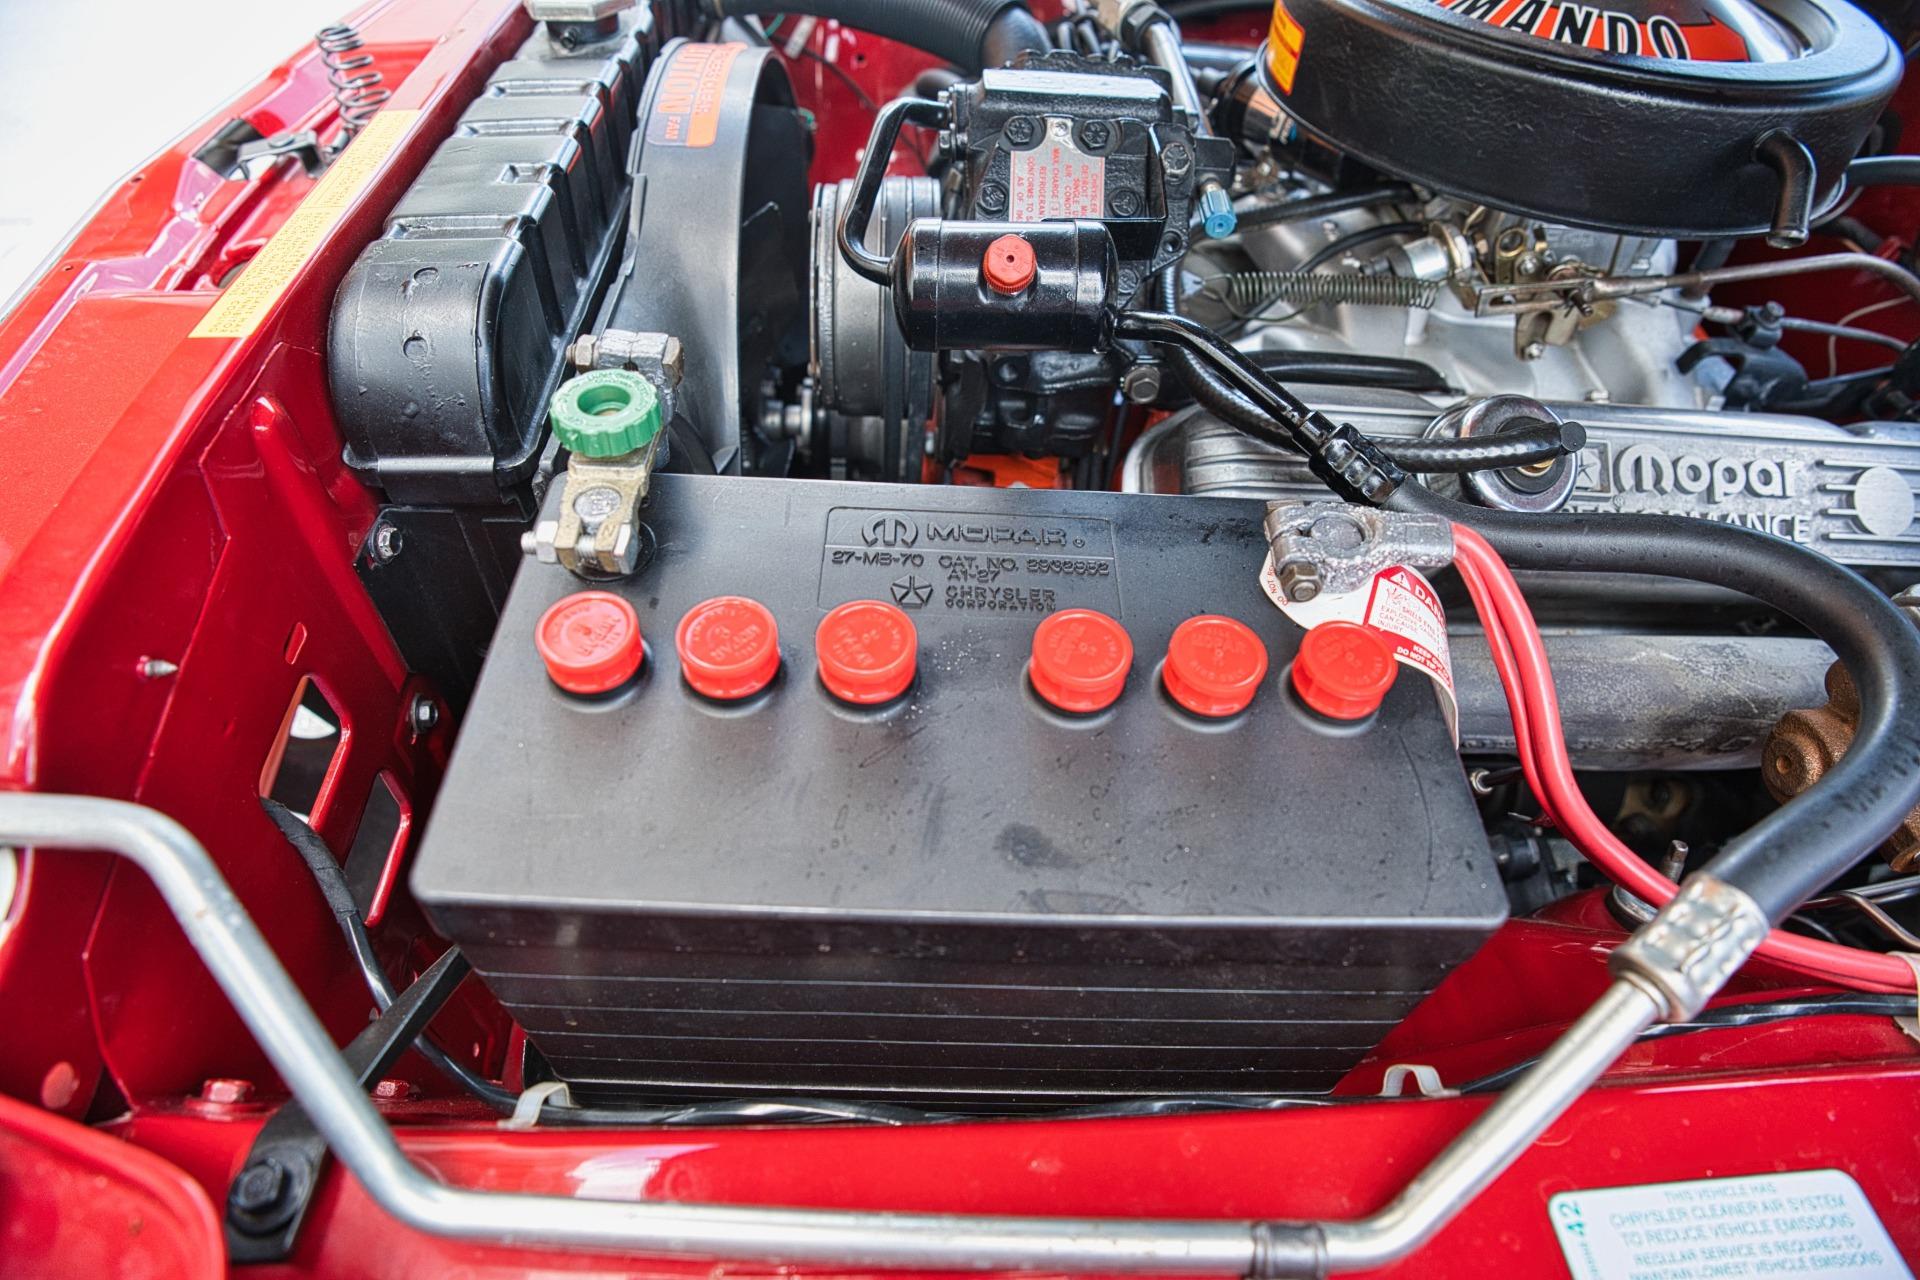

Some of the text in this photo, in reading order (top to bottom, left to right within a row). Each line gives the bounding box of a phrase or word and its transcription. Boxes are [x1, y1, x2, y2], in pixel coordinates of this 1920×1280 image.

[665, 116, 681, 139] FAN
[1017, 176, 1024, 186] AS
[1026, 156, 1035, 199] CONFORMS
[1064, 164, 1072, 178] AIR
[1081, 165, 1089, 198] DETROIT
[1052, 168, 1060, 199] CHARGE
[1026, 203, 1034, 212] TO
[1613, 443, 1804, 504] Mopar
[927, 522, 1067, 546] MOPAR
[938, 555, 979, 571] CAT.
[987, 557, 1019, 573] NO.
[947, 569, 1000, 583] A1-27
[945, 585, 1056, 601] CHRYSLER
[945, 600, 1057, 613] CORPORATION
[1396, 646, 1410, 656] DO
[1409, 650, 1425, 663] NOT
[1697, 1184, 1747, 1199] VEHICLE
[1611, 1193, 1846, 1225] CHRYSLER CLEANER AIR SYSTEM
[1623, 1211, 1855, 1246] TO REDUCE VEHICLE EMISSIONS
[1700, 1243, 1753, 1259] SERVICE
[1774, 1235, 1841, 1253] REQUIRED
[1755, 1258, 1807, 1273] VEHICLE
[1810, 1251, 1884, 1269] EMISSIONS
